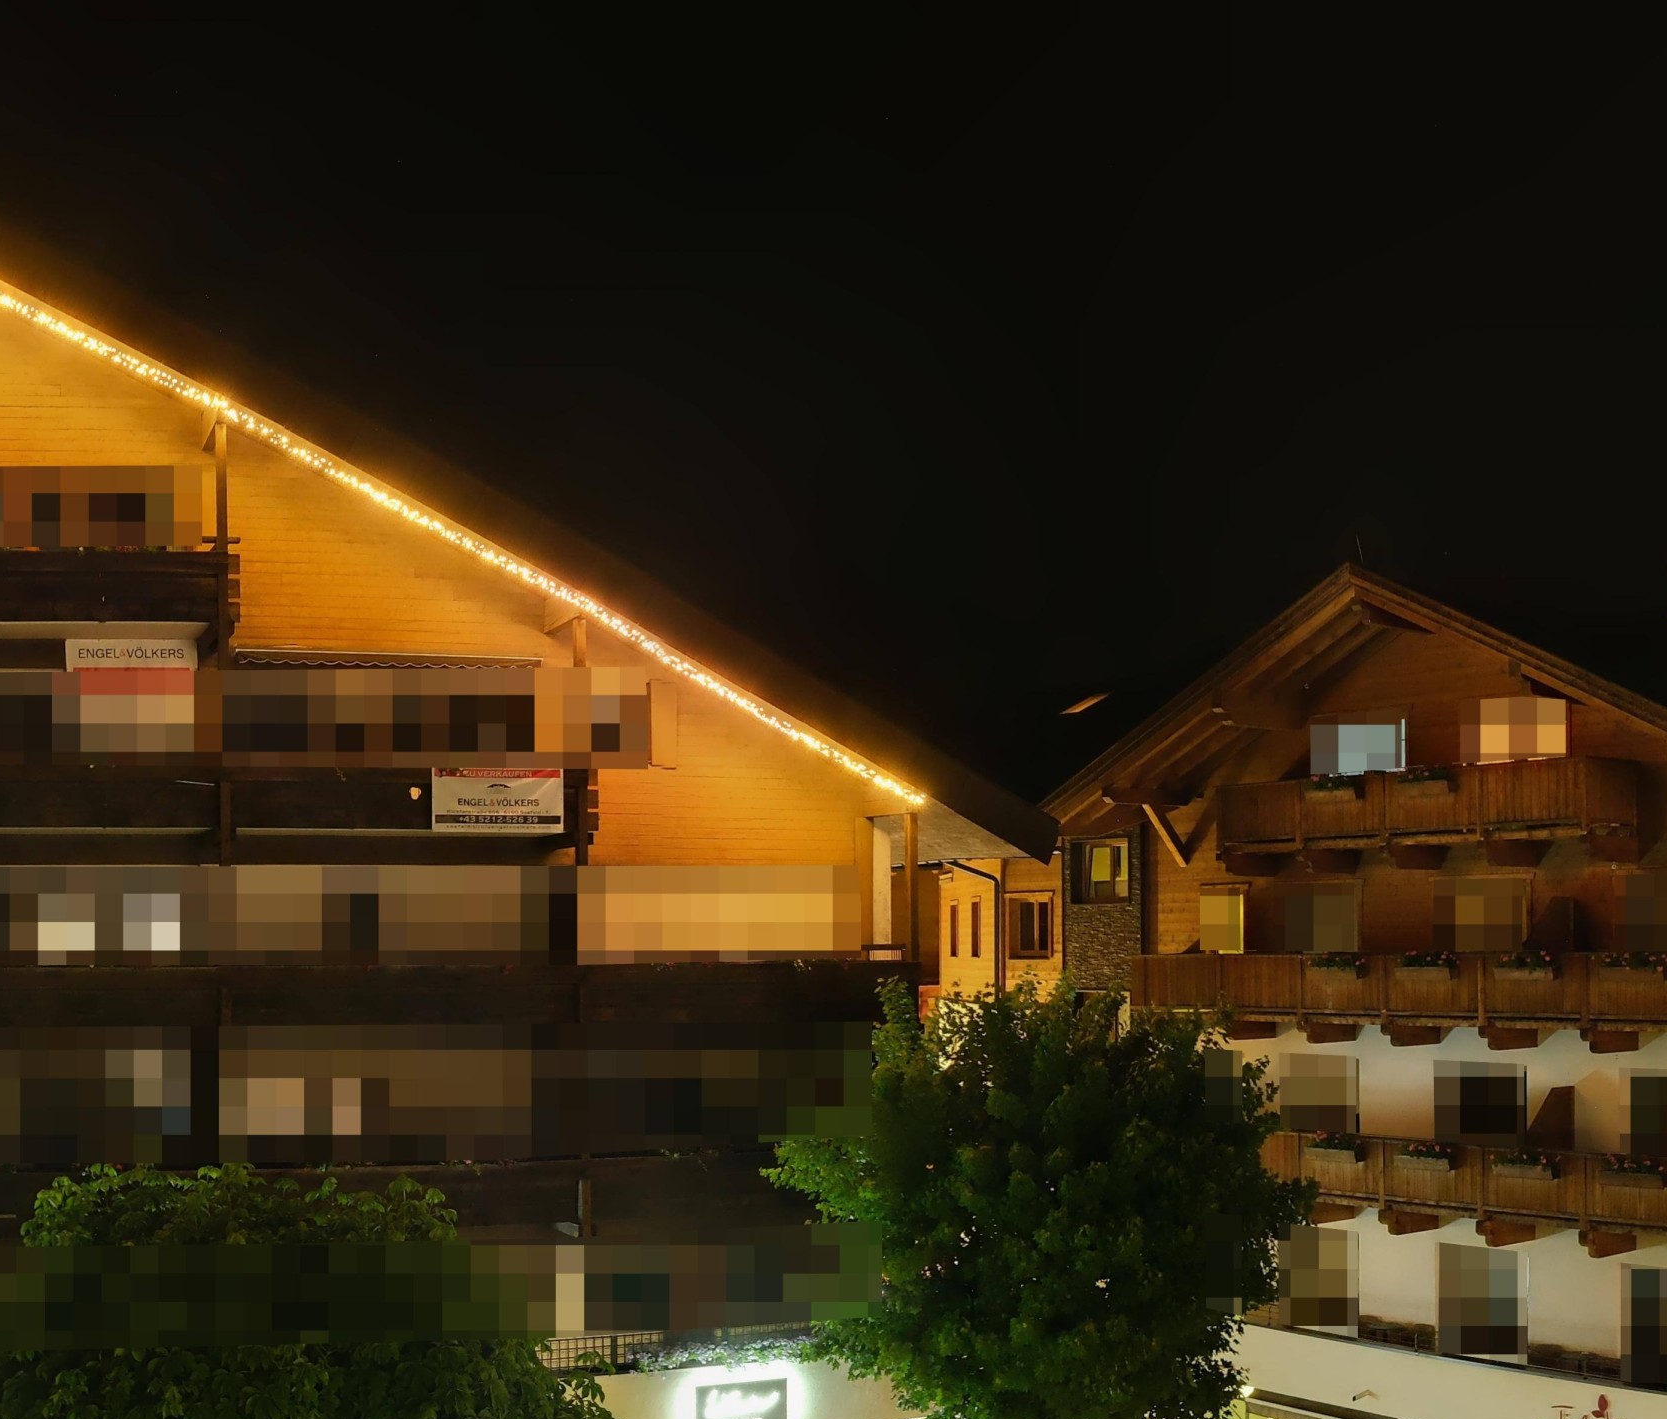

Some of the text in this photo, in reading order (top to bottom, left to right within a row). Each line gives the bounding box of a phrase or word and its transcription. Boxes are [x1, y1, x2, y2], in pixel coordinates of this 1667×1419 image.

[78, 646, 185, 659] ENGEL&VÖLKERS
[477, 770, 533, 778] VERKAUFEN
[457, 797, 540, 807] ENGEL&VÖLKERS
[525, 816, 539, 824] 39
